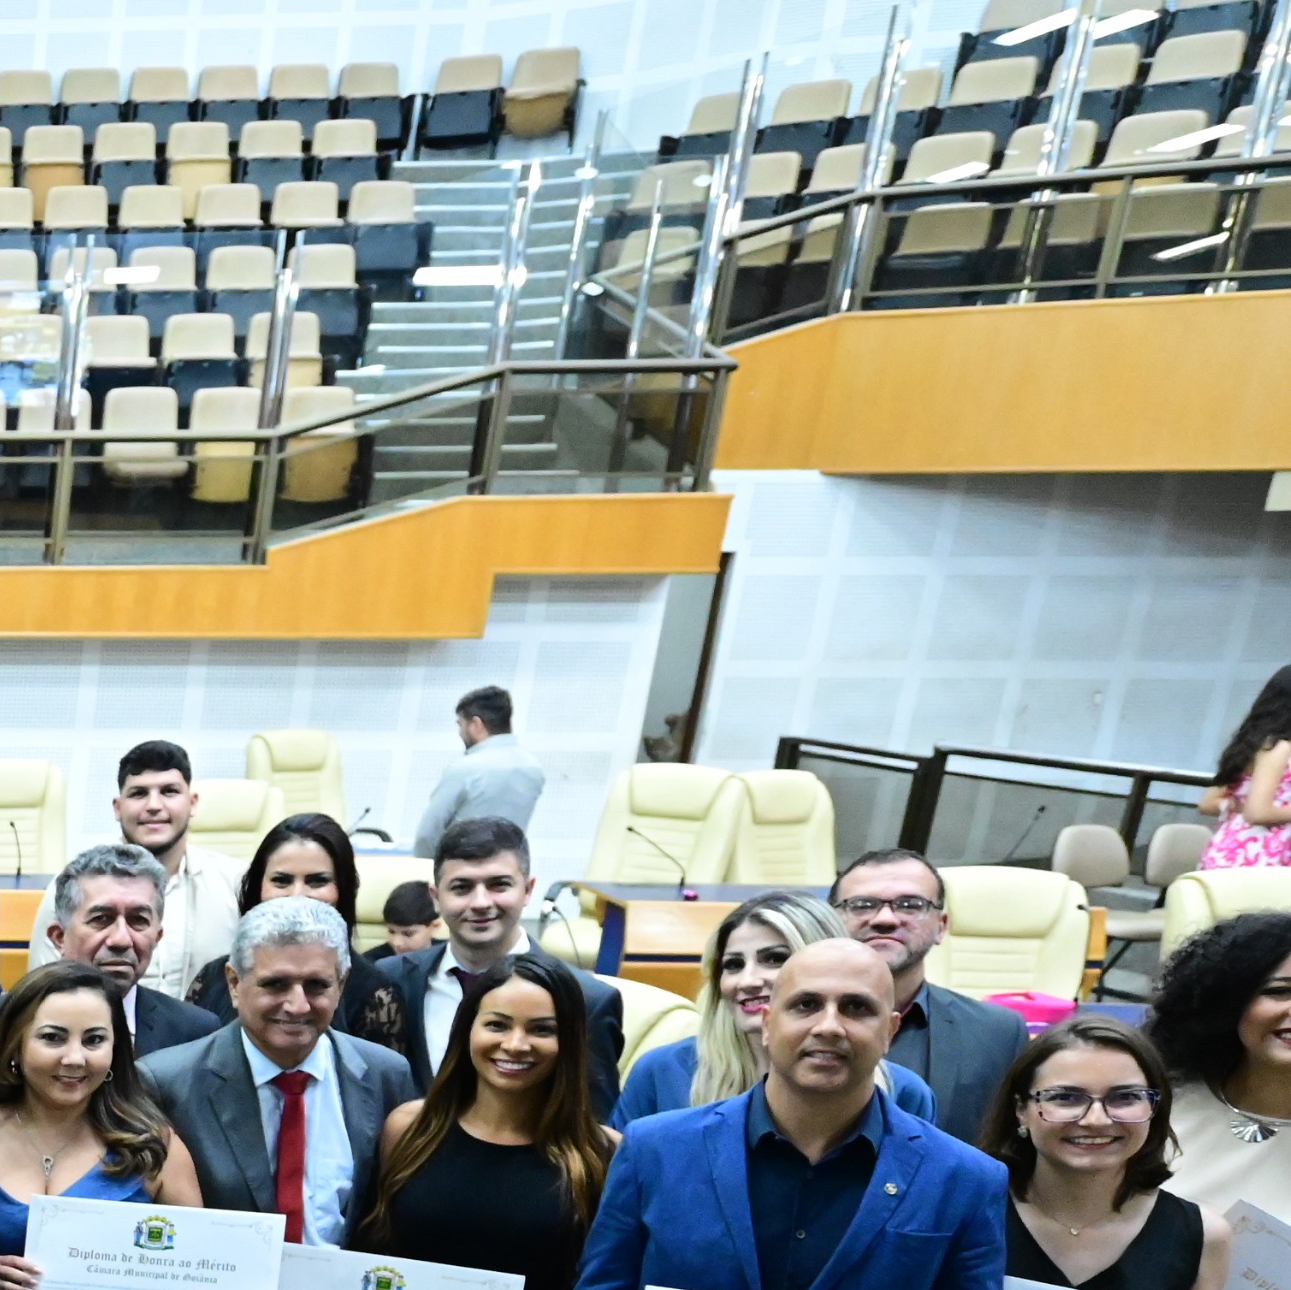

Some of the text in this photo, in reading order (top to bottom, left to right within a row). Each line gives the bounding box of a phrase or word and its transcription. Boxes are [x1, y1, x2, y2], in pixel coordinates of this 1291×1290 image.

[68, 1246, 236, 1272] Diploma de Honra ao Mérito
